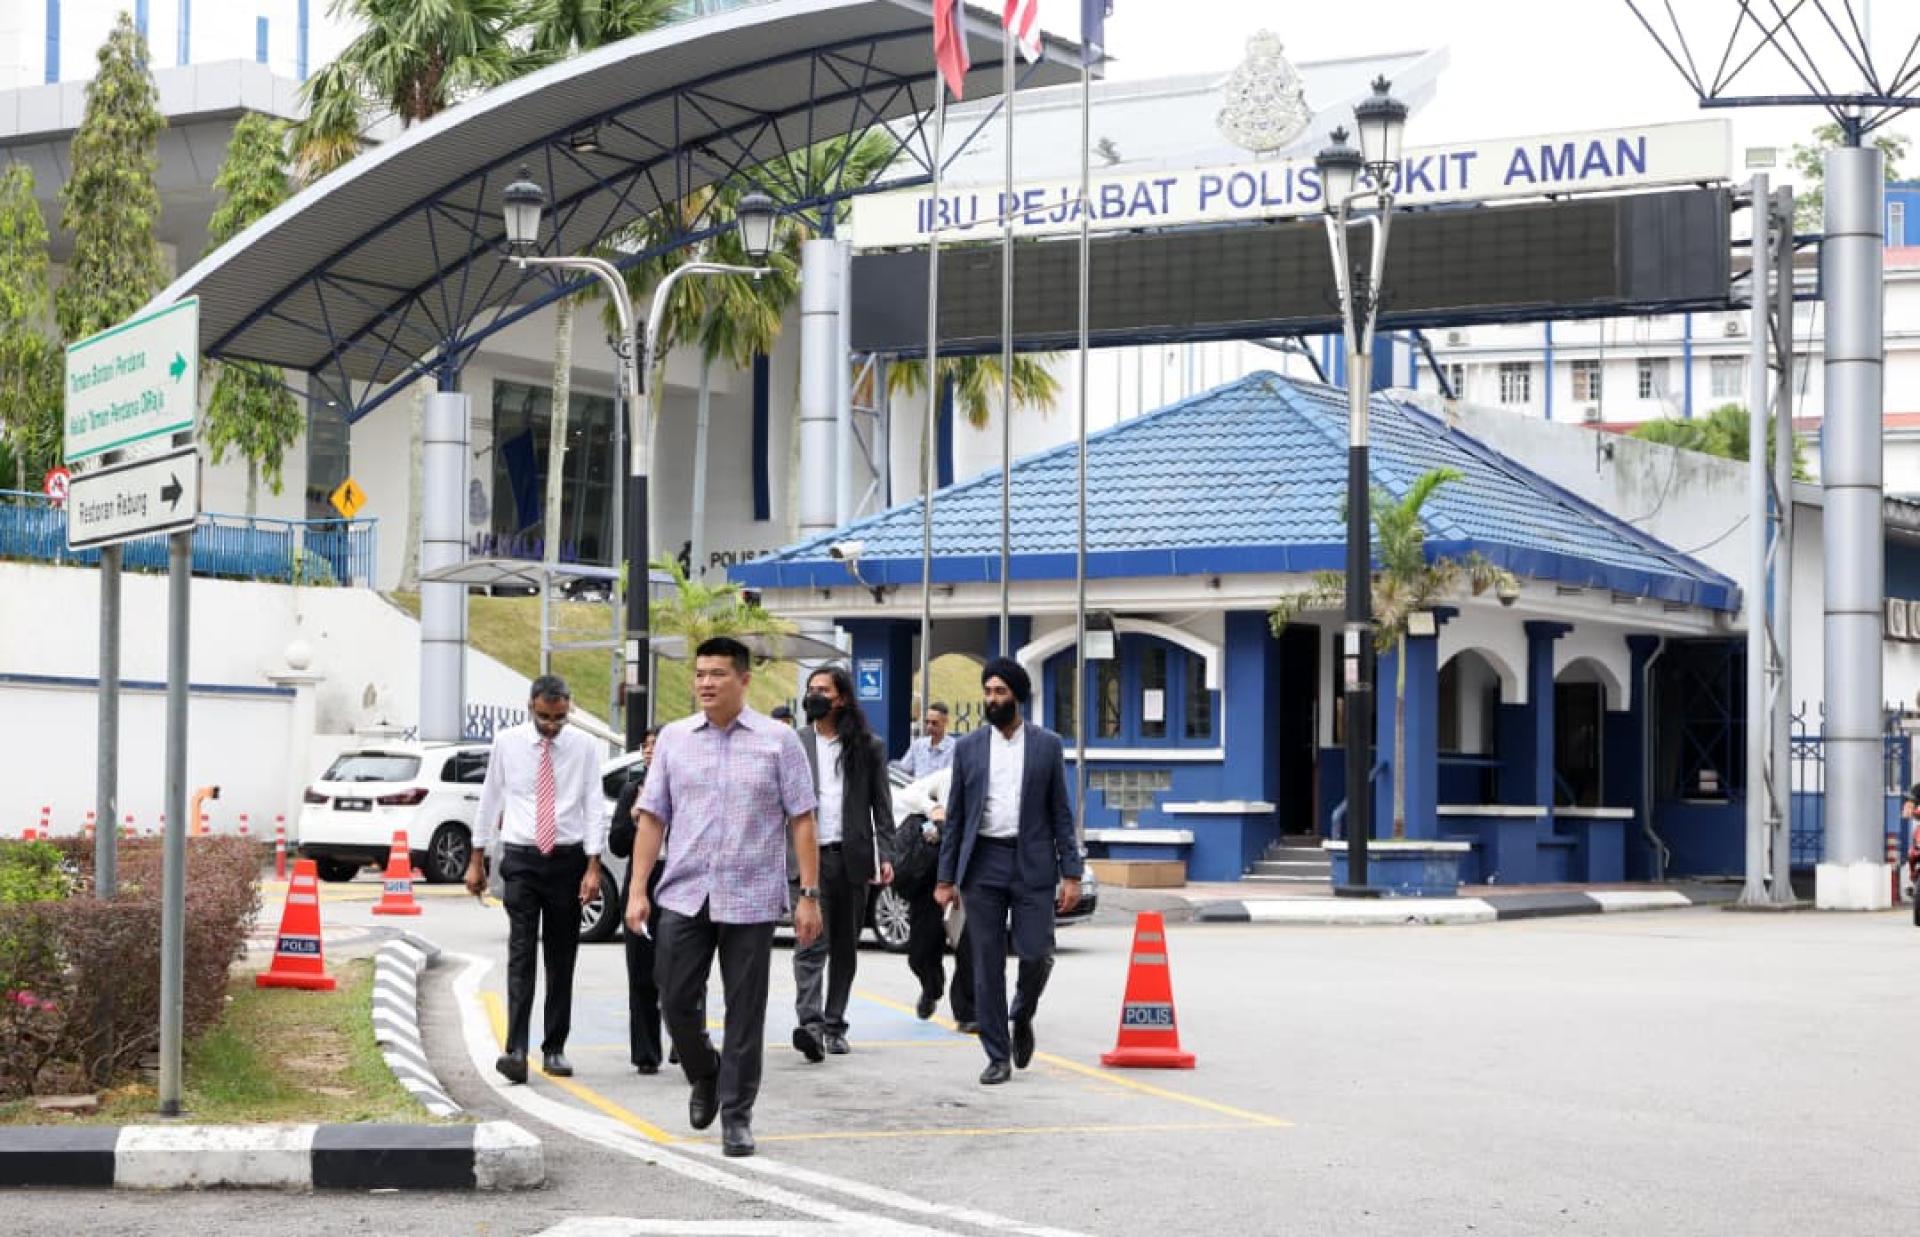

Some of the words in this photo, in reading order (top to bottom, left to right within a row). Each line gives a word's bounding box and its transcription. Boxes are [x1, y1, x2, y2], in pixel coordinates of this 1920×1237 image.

[918, 194, 977, 234] IBU
[998, 178, 1178, 228] PEJABAT
[1199, 169, 1321, 211] POLIS
[1503, 136, 1647, 186] AMAN
[80, 500, 113, 524] Restoran
[117, 492, 147, 517] Rebung
[281, 939, 316, 951] POLIS
[1126, 1008, 1170, 1024] POLIS
